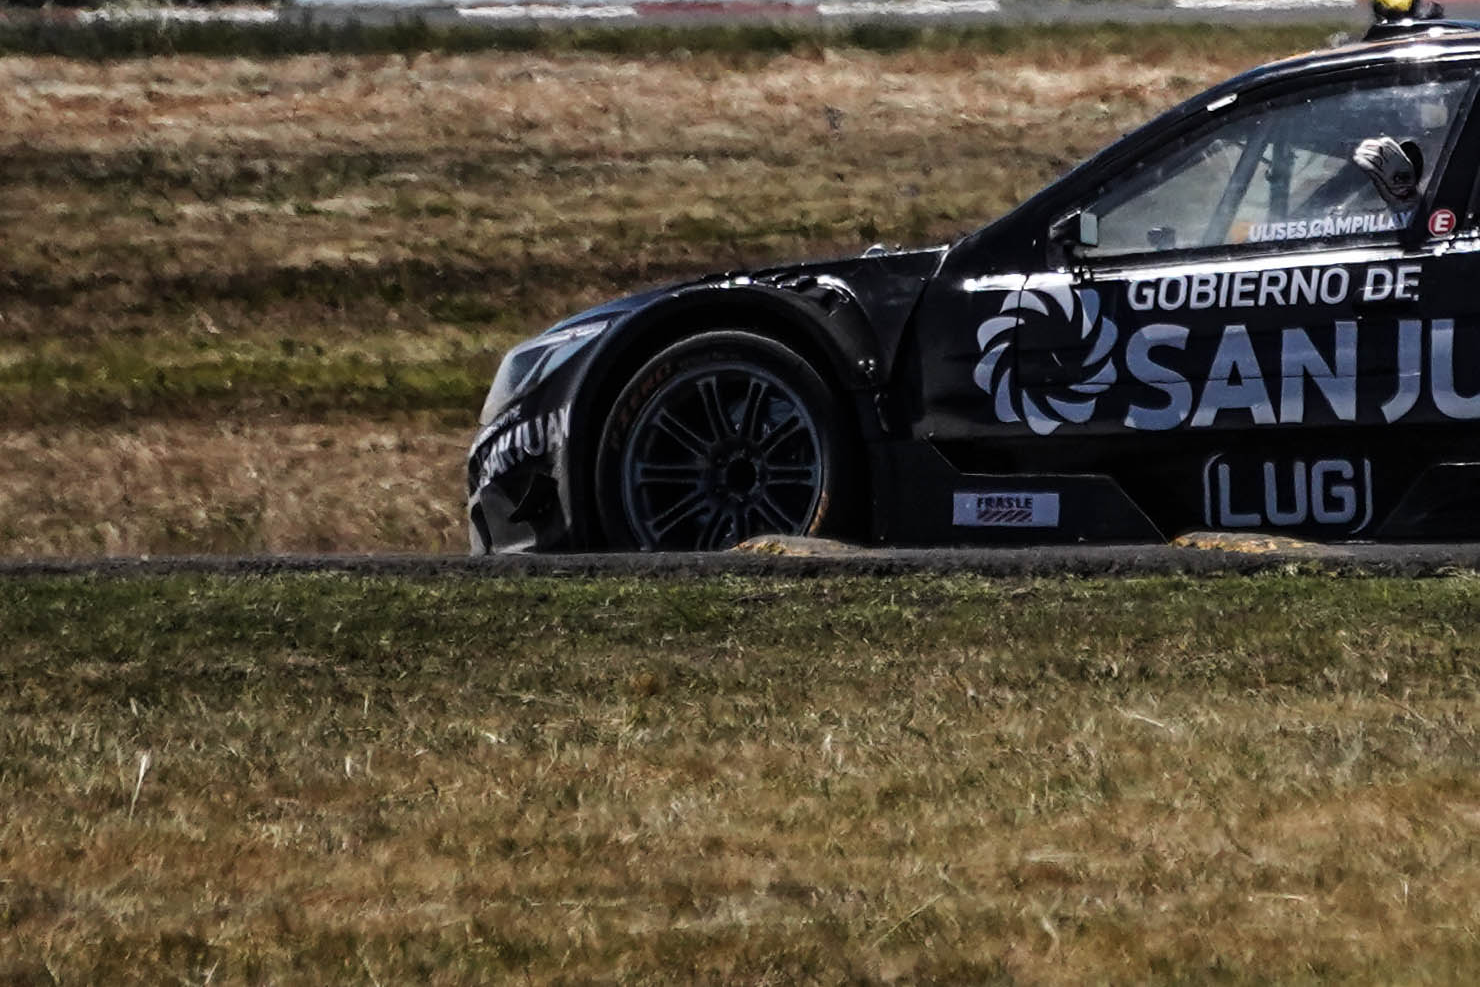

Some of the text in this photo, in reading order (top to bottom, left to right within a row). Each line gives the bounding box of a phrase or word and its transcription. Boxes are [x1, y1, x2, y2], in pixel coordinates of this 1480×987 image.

[1248, 221, 1307, 242] ULISES
[1434, 213, 1451, 232] E
[1127, 265, 1423, 310] GOBIERNO DE
[1124, 320, 1358, 430] SAN
